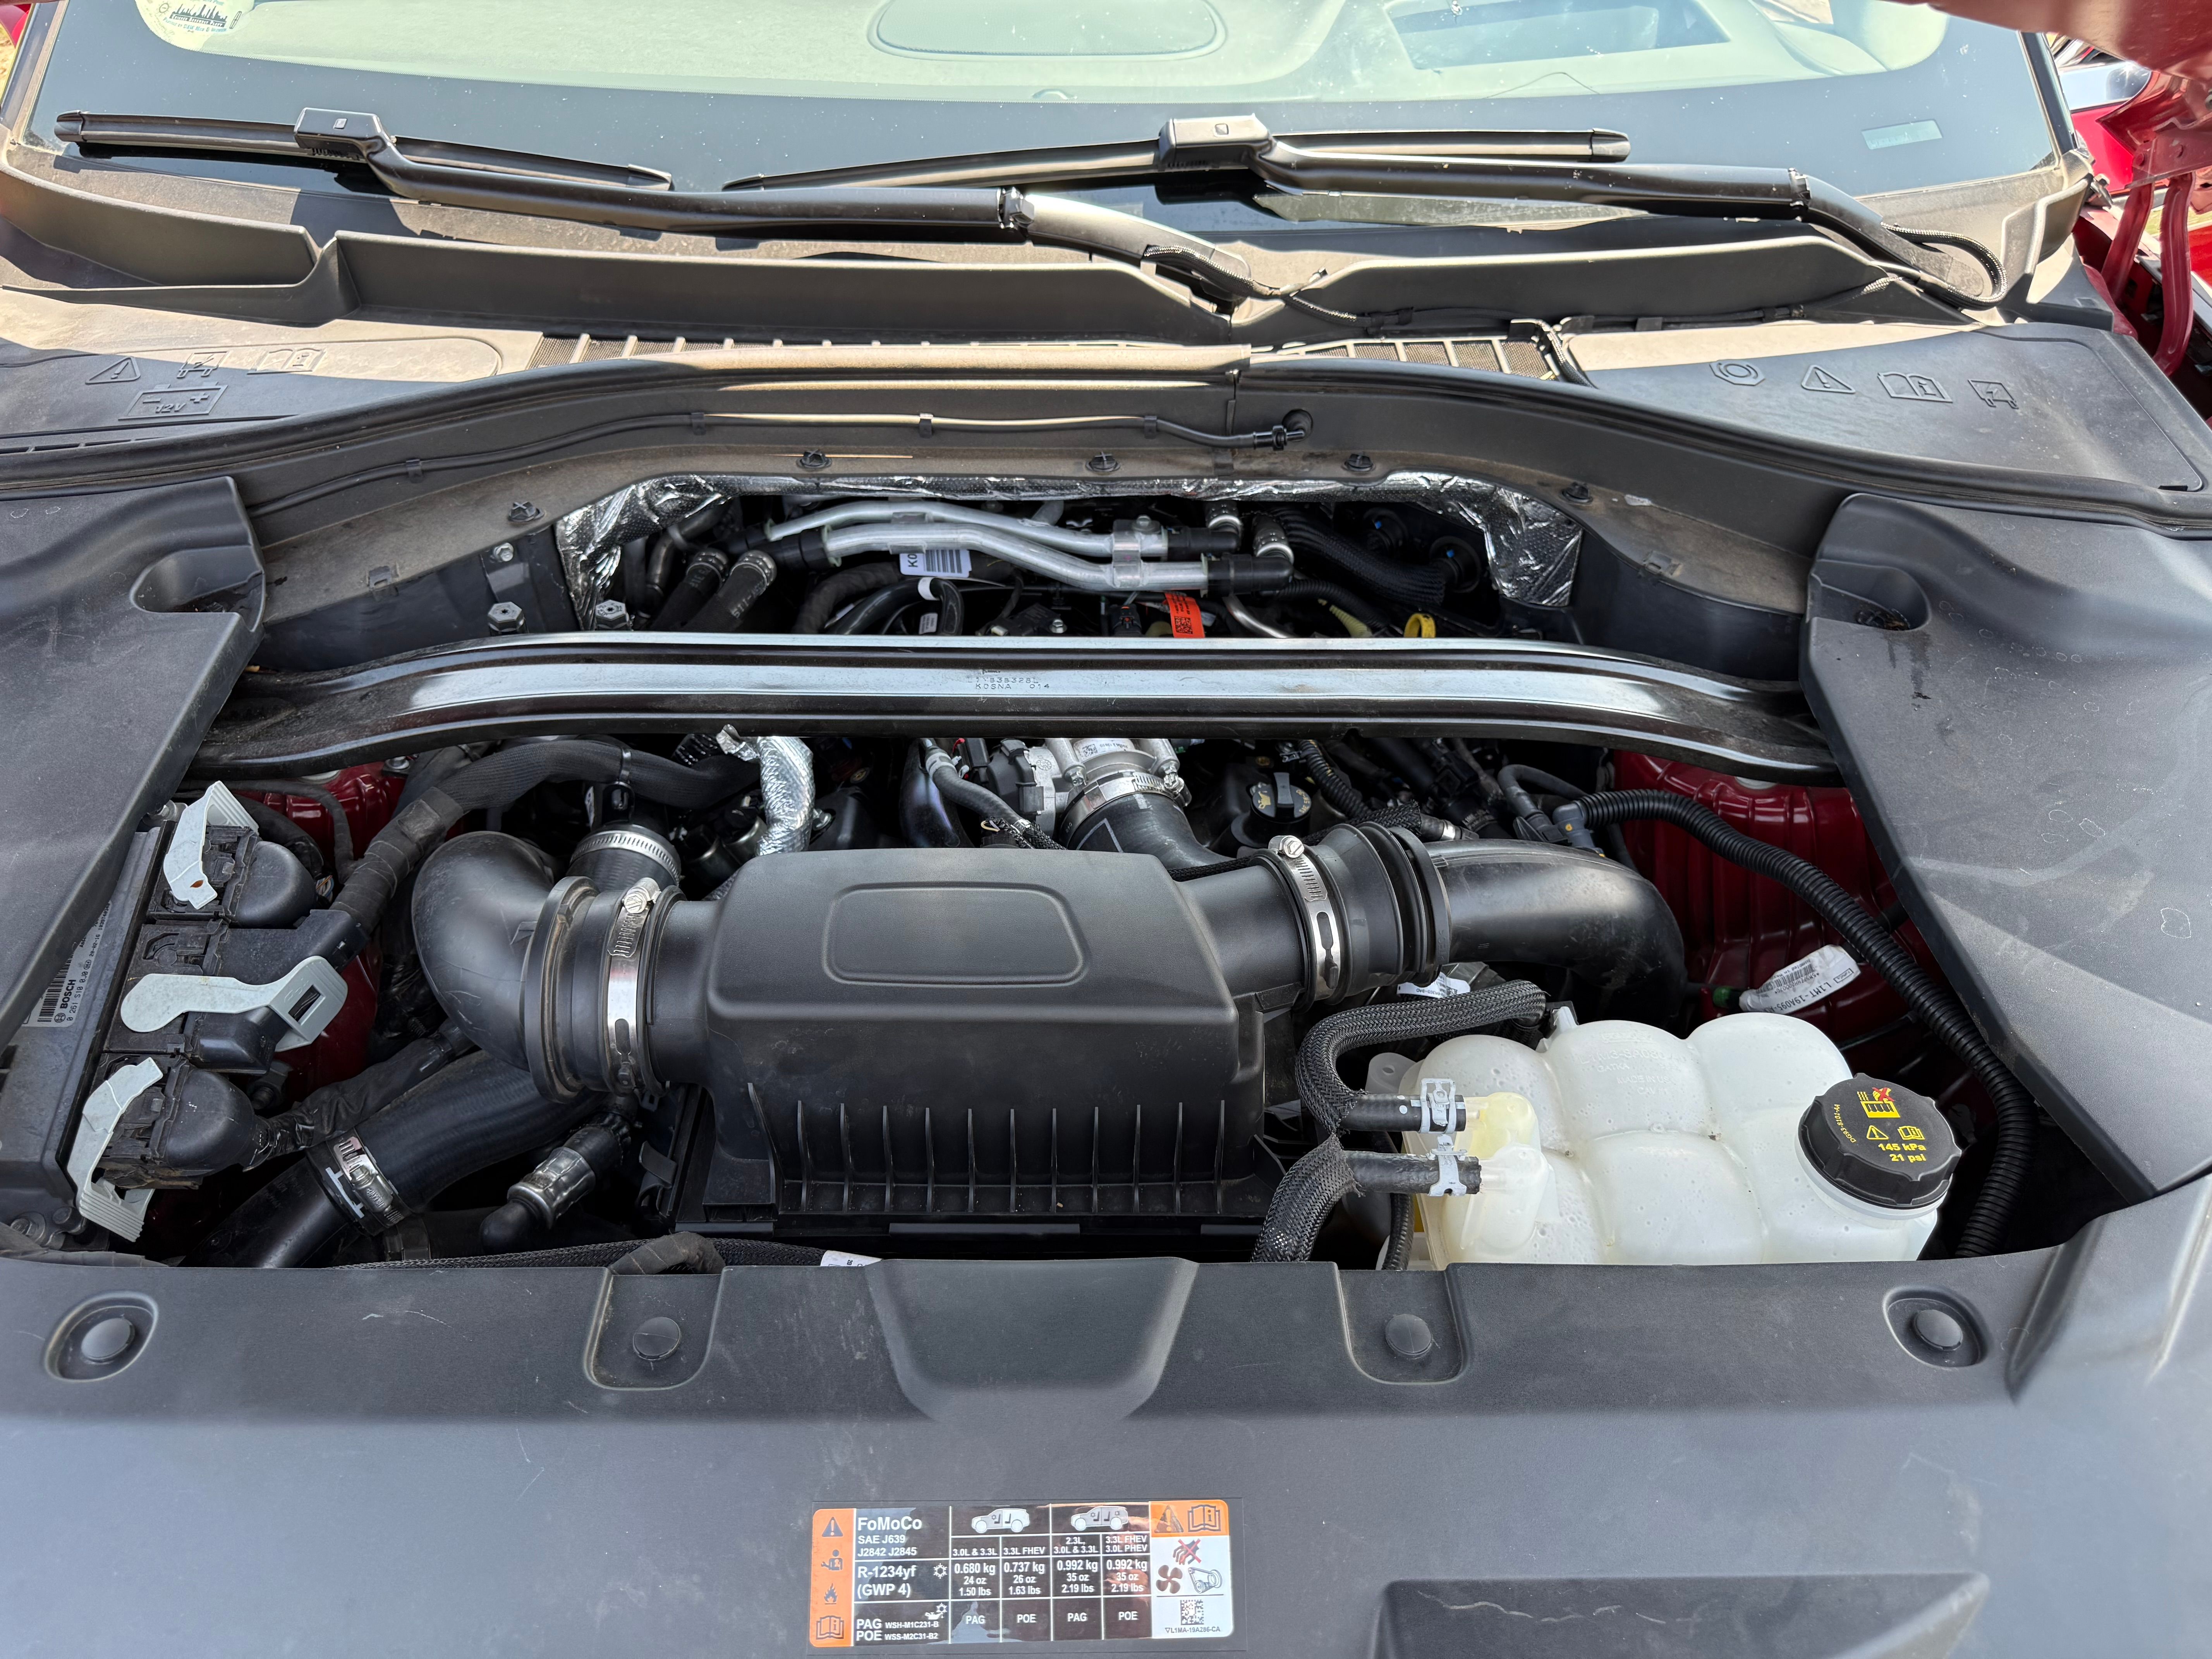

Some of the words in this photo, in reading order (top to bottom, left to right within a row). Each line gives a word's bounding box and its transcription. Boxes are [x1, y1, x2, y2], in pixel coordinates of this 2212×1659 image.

[155, 403, 186, 414] 12V
[60, 979, 76, 1009] BOSCH
[69, 1003, 78, 1013] 261
[1908, 1154, 1926, 1163] psi
[857, 1516, 922, 1530] FoMoCo
[858, 1535, 880, 1544] SAE
[882, 1534, 905, 1544] J639
[1066, 1537, 1085, 1545] 2.3L,
[857, 1547, 886, 1557] J2842
[888, 1547, 917, 1556] J2845
[980, 1547, 998, 1556] 3.3L
[1003, 1547, 1021, 1555] 3.3L
[1022, 1546, 1045, 1554] FHEV
[1081, 1545, 1099, 1553] 3.3L
[954, 1563, 981, 1574] 0.680
[983, 1562, 996, 1575] kg
[1004, 1561, 1030, 1573] 0.737
[1033, 1561, 1045, 1574] kg
[1057, 1559, 1084, 1571] 0.992
[1086, 1559, 1098, 1572] kg
[1106, 1559, 1133, 1570] 0.992
[1135, 1559, 1147, 1571] kg
[857, 1565, 917, 1580] R-1234yf
[1066, 1572, 1077, 1582] 35
[1116, 1572, 1127, 1581] 35
[963, 1575, 974, 1585] 24
[1013, 1575, 1024, 1583] 26
[857, 1583, 895, 1599] (GWP
[898, 1583, 911, 1598] 4)
[959, 1587, 976, 1596] 1.50
[978, 1586, 992, 1595] lbs
[1008, 1585, 1025, 1595] 1.63
[1028, 1585, 1041, 1595] lbs
[1061, 1583, 1079, 1593] 2.19
[1081, 1583, 1094, 1592] lbs
[1111, 1583, 1128, 1592] 2.19
[1131, 1583, 1144, 1592] lbs
[966, 1615, 986, 1624] PAG
[1017, 1613, 1037, 1623] POE
[1067, 1612, 1087, 1622] PAG
[1118, 1611, 1139, 1620] POE
[856, 1618, 882, 1629] PAG
[885, 1621, 939, 1629] WSH-M1C231-B
[856, 1630, 882, 1641] POE
